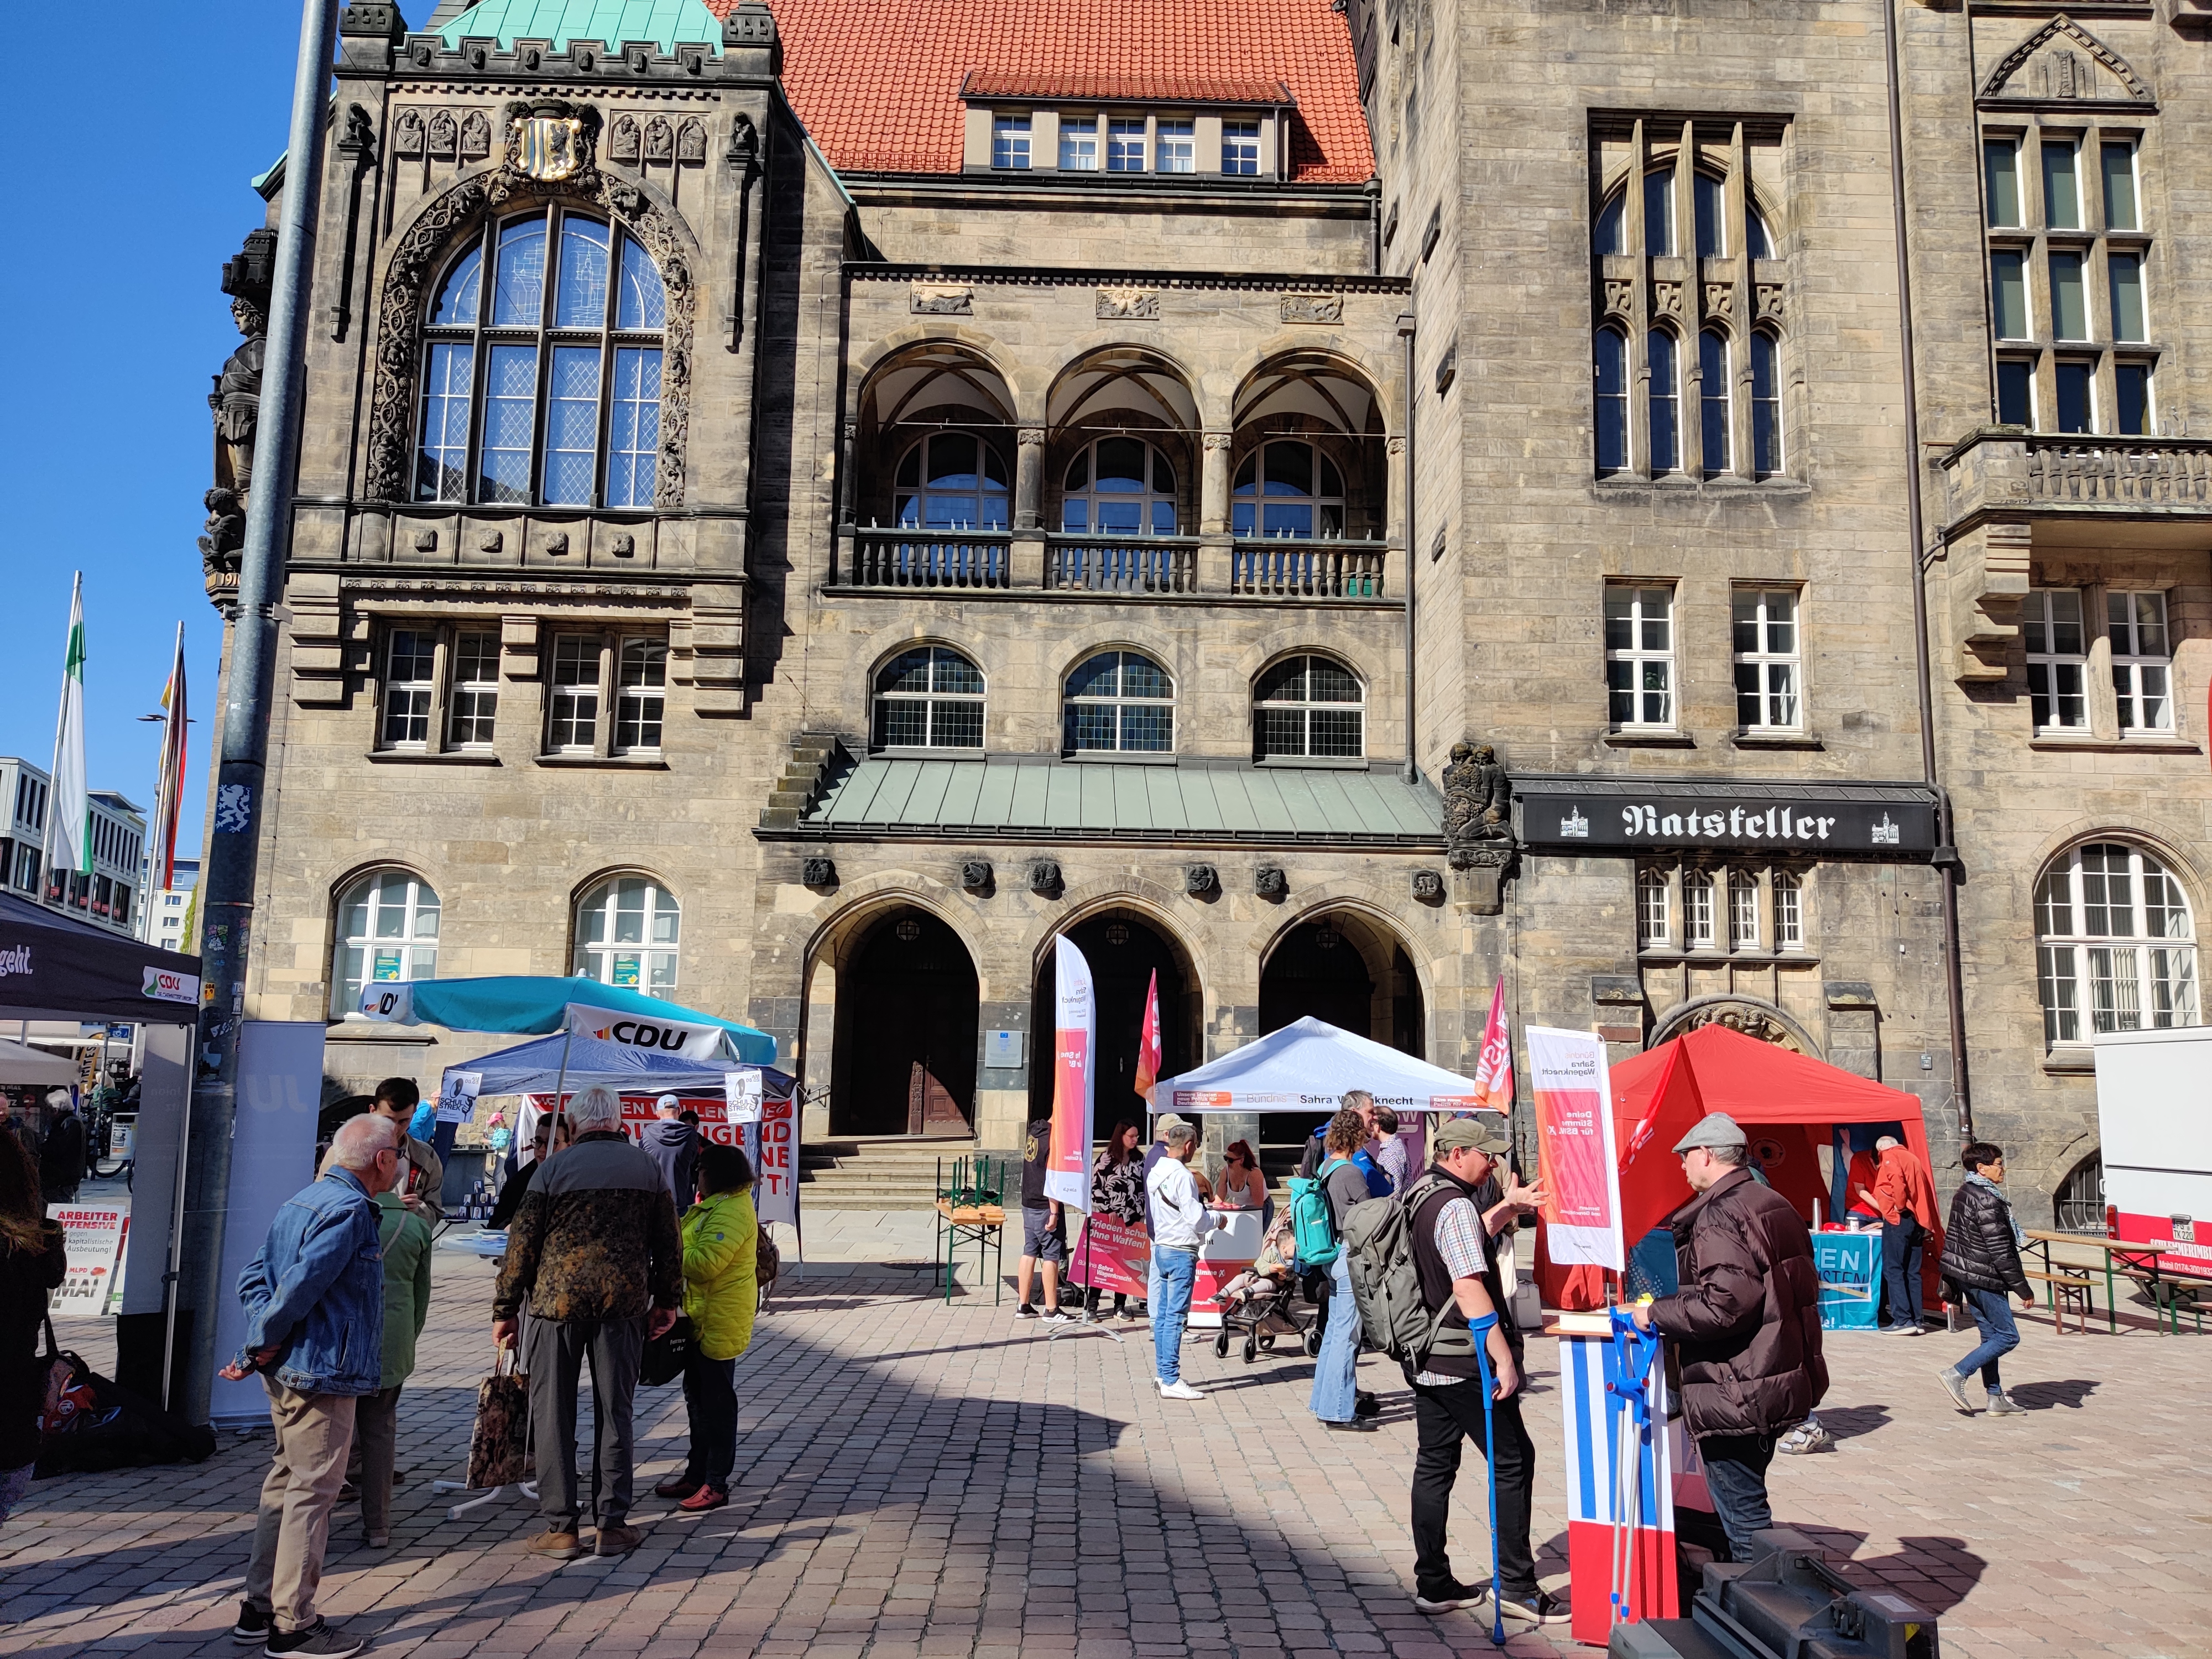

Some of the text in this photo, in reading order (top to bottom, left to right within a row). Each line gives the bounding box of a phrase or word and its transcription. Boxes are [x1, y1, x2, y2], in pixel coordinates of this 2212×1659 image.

[1622, 805, 1835, 840] Ratskeller
[158, 974, 181, 990] CDU
[612, 1021, 688, 1051] CDU
[440, 1097, 464, 1106] SCHUL
[1246, 1093, 1287, 1103] Bündnis
[1300, 1095, 1332, 1104] Sahra
[58, 1211, 118, 1221] ARBEITER
[61, 1220, 117, 1230] FFENSIVE
[1091, 1218, 1123, 1233] Frieden
[2173, 1229, 2194, 1241] TK 220
[1112, 1233, 1146, 1250] Waffen!
[67, 1245, 112, 1254] Ausbeutung!
[2159, 1260, 2174, 1269] Mobil
